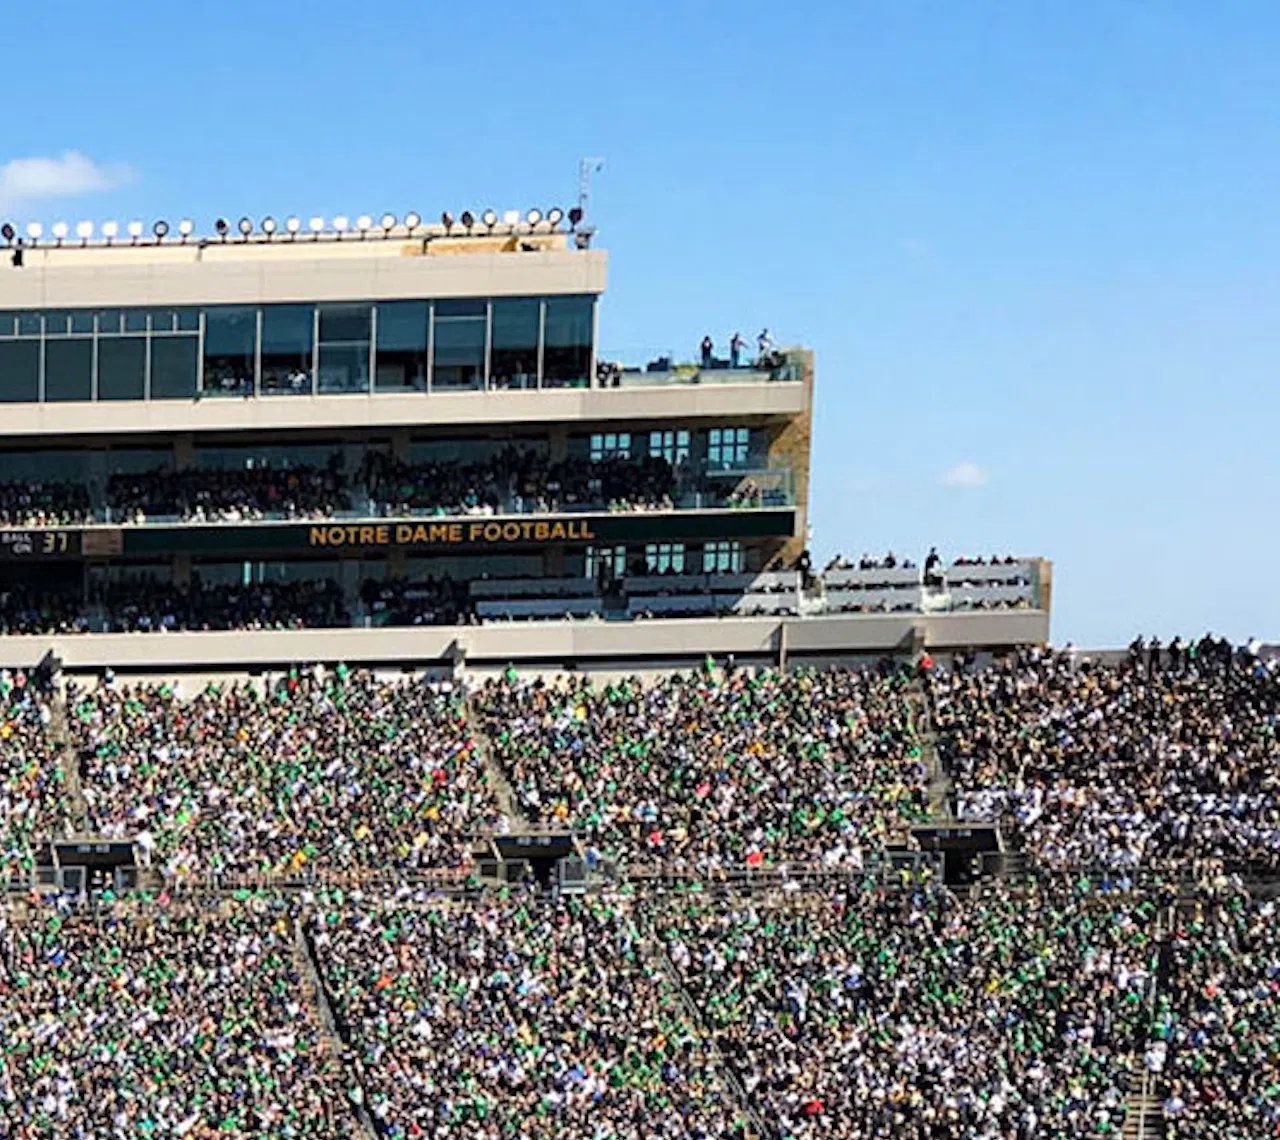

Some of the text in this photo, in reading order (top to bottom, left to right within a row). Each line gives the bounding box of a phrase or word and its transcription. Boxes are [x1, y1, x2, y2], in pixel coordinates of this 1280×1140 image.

[42, 533, 68, 553] 37
[309, 520, 595, 546] NOTRE DAME FOOTBALL
